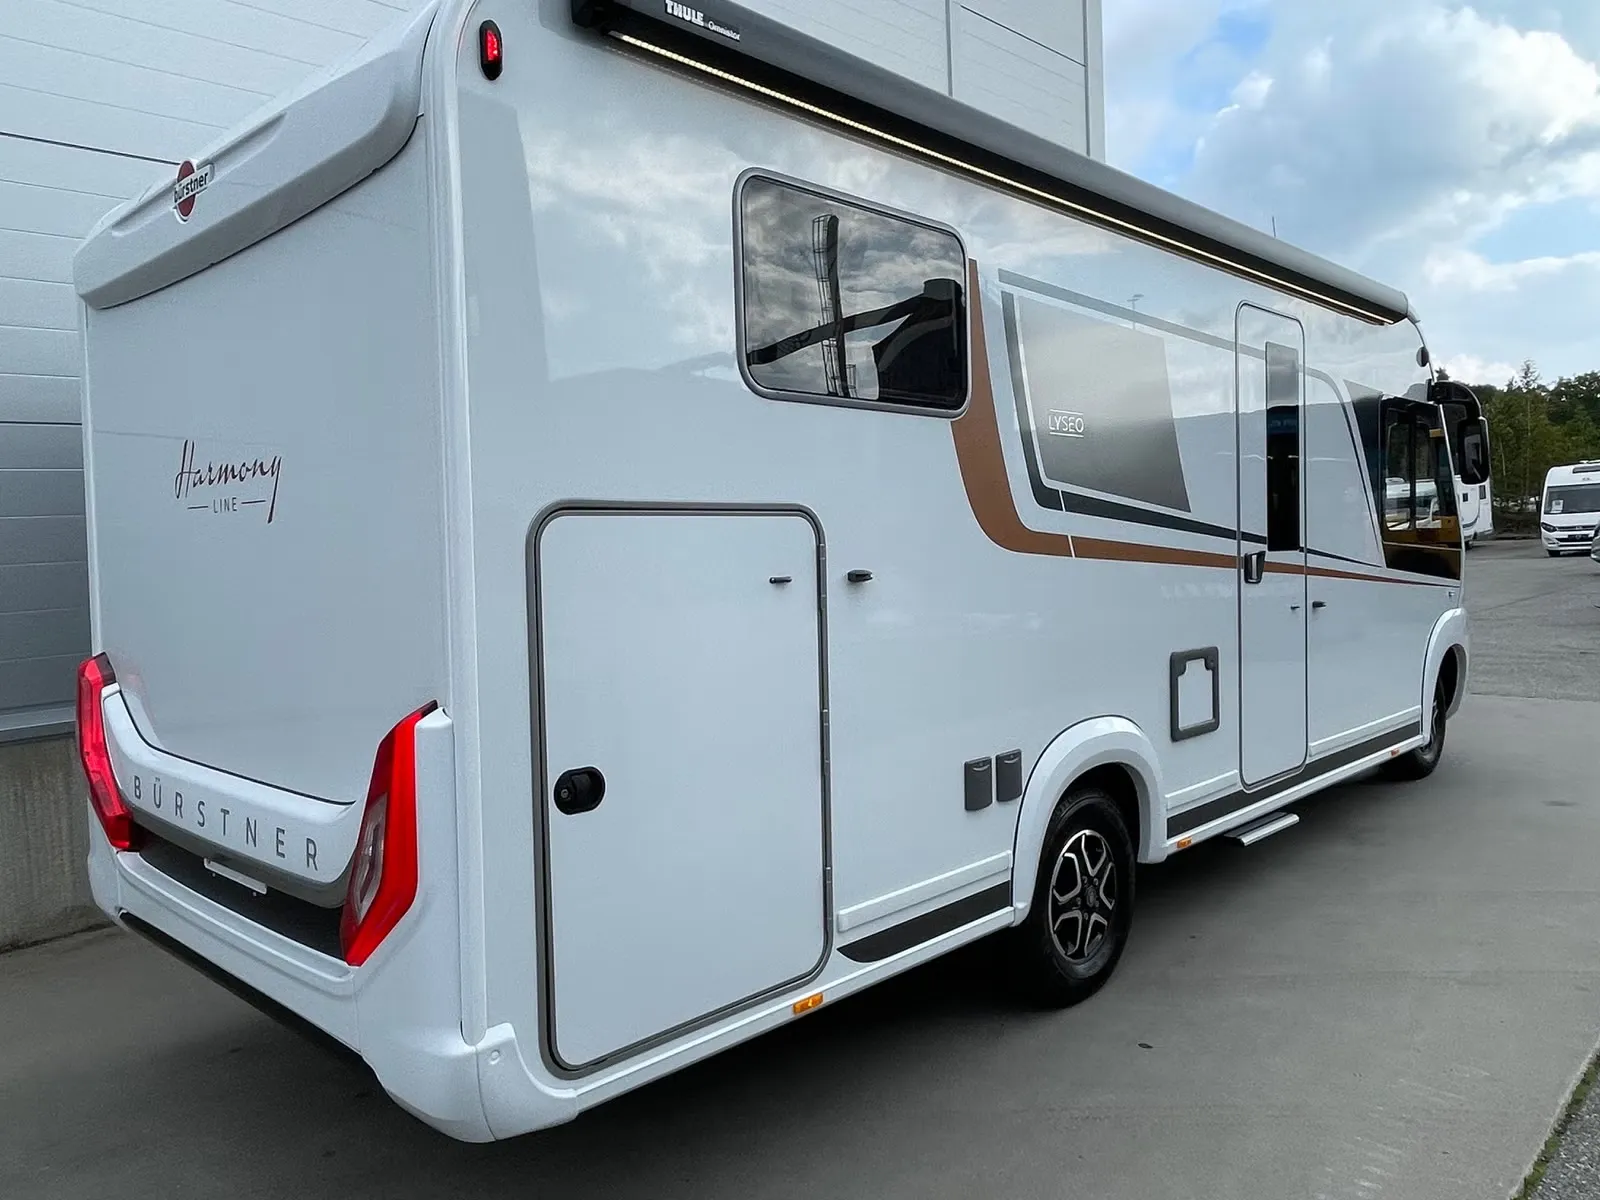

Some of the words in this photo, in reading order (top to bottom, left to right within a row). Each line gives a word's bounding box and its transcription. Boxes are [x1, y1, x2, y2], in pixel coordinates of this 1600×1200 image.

[665, 0, 704, 27] THULE
[174, 172, 209, 203] bürstner
[1048, 415, 1084, 433] LYSEO
[174, 439, 282, 524] Harmony
[213, 497, 238, 514] LINE
[133, 775, 319, 871] BÜRSTNER
